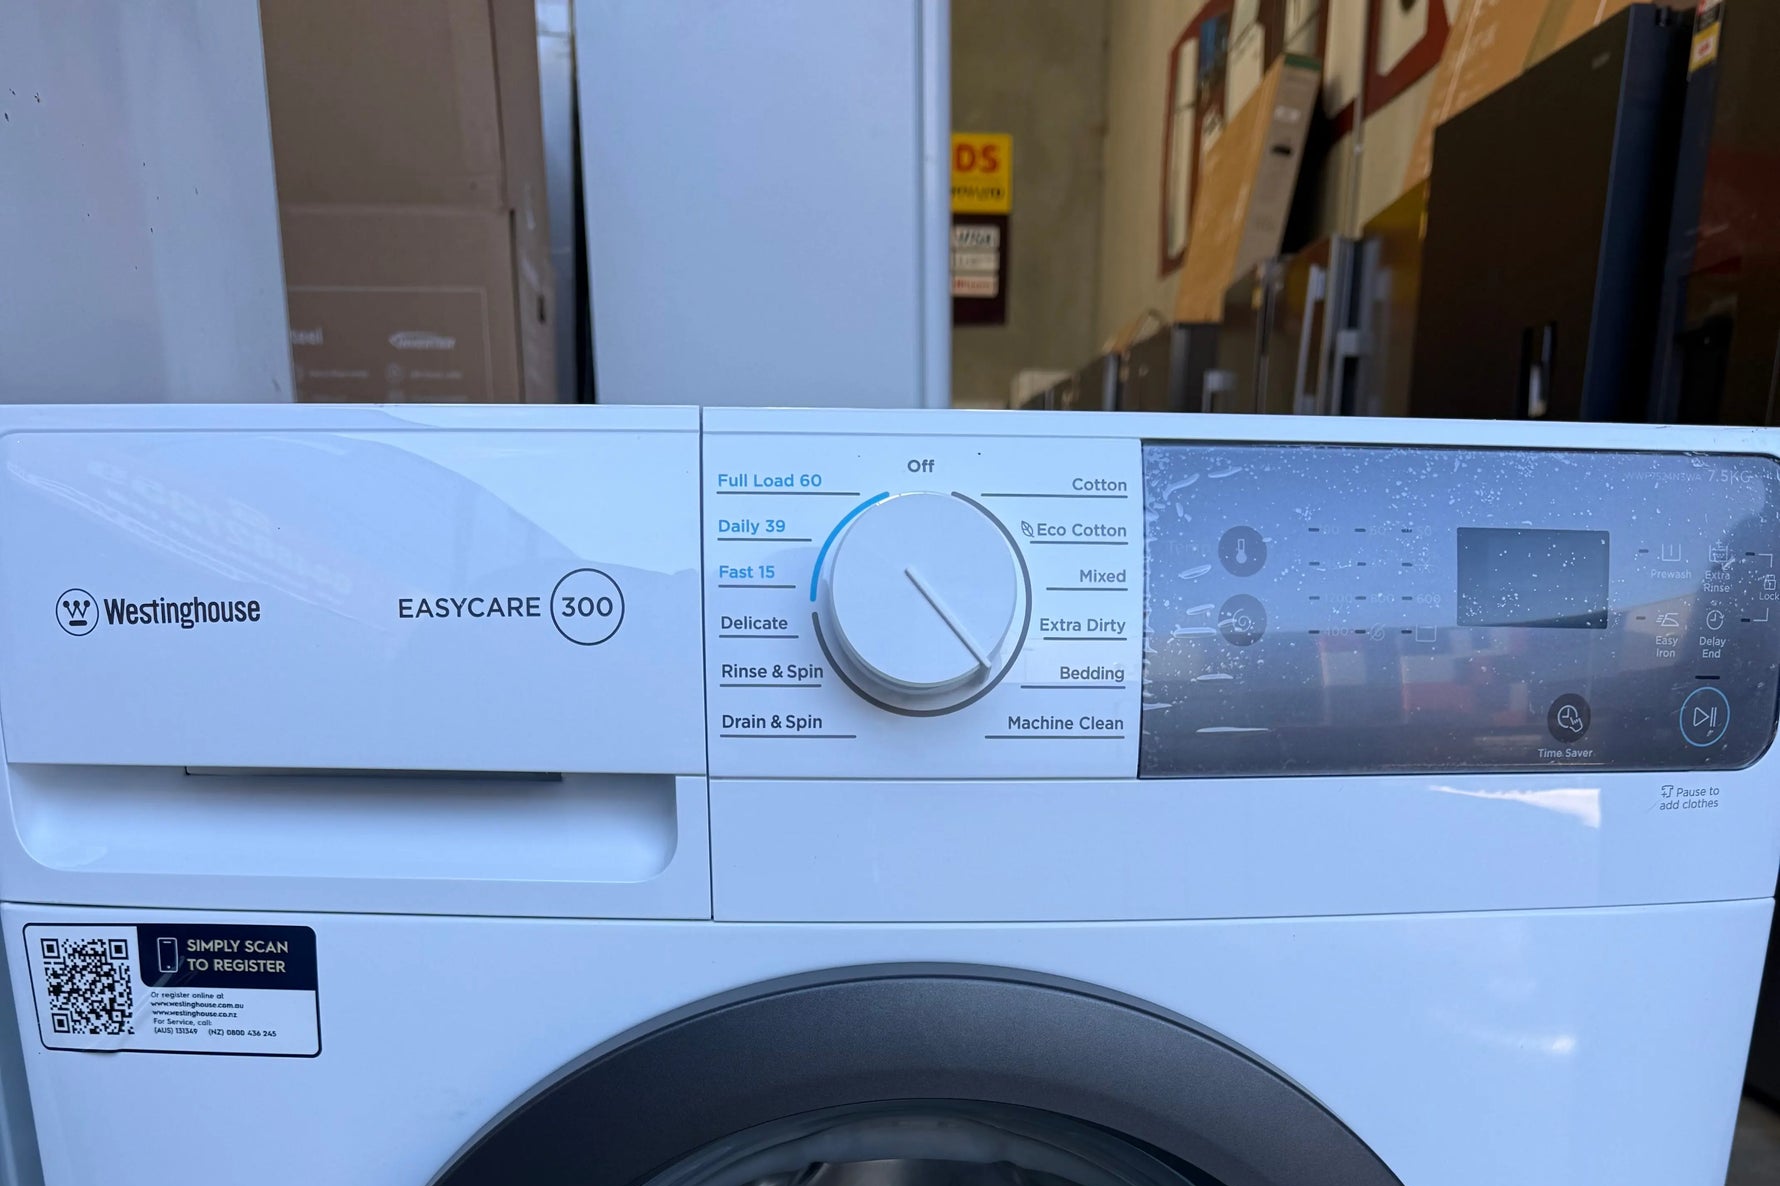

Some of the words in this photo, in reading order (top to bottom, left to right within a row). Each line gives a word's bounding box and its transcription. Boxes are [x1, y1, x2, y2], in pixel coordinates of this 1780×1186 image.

[907, 459, 935, 473] Off
[717, 474, 748, 488] Full
[753, 474, 794, 488] Load
[799, 474, 822, 488] 60
[1072, 478, 1127, 492] Cotton
[718, 519, 760, 536] Daily
[765, 520, 786, 533] 39
[1036, 523, 1066, 537] Eco
[1072, 523, 1127, 538] Cotton
[718, 565, 753, 579] Fast
[758, 566, 775, 579] 15
[1079, 569, 1127, 584] Mixed
[1650, 569, 1692, 579] Prewash
[1704, 570, 1731, 580] Extra
[1703, 583, 1730, 592] Rinse
[1759, 592, 1780, 600] Lock
[103, 596, 262, 630] Westinghouse
[398, 597, 541, 618] EASYCARE
[561, 596, 613, 617] 300
[720, 616, 788, 630] Delicate
[1039, 618, 1082, 633] Extra
[1086, 618, 1126, 635] Dirty
[1656, 636, 1678, 646] Easy
[1699, 637, 1727, 647] Delay
[1656, 649, 1675, 658] Iron
[1702, 649, 1721, 658] End
[721, 664, 768, 679] Rinse
[772, 664, 783, 678] &
[786, 664, 824, 682] Spin
[1059, 666, 1125, 683] Bedding
[721, 715, 766, 729] Drain
[770, 715, 782, 729] &
[785, 714, 822, 732] Spin
[1007, 716, 1074, 731] Machine
[1079, 716, 1124, 731] Clean
[1538, 749, 1562, 758] Time
[1565, 749, 1593, 758] Saver
[1676, 787, 1706, 797] Pause
[1709, 787, 1719, 795] to
[1660, 800, 1679, 810] add
[1682, 799, 1719, 809] clothes
[187, 939, 240, 954] SIMPLY
[245, 940, 289, 954] SCAN
[187, 958, 209, 972] TO
[213, 959, 287, 973] REGISTER
[150, 1001, 244, 1009] www.westinghouse.com.au
[152, 1009, 238, 1018] www.westinghouse.co.nz
[167, 1018, 196, 1026] Service,
[154, 1027, 174, 1035] (AUS)
[208, 1028, 225, 1036] (NZ)
